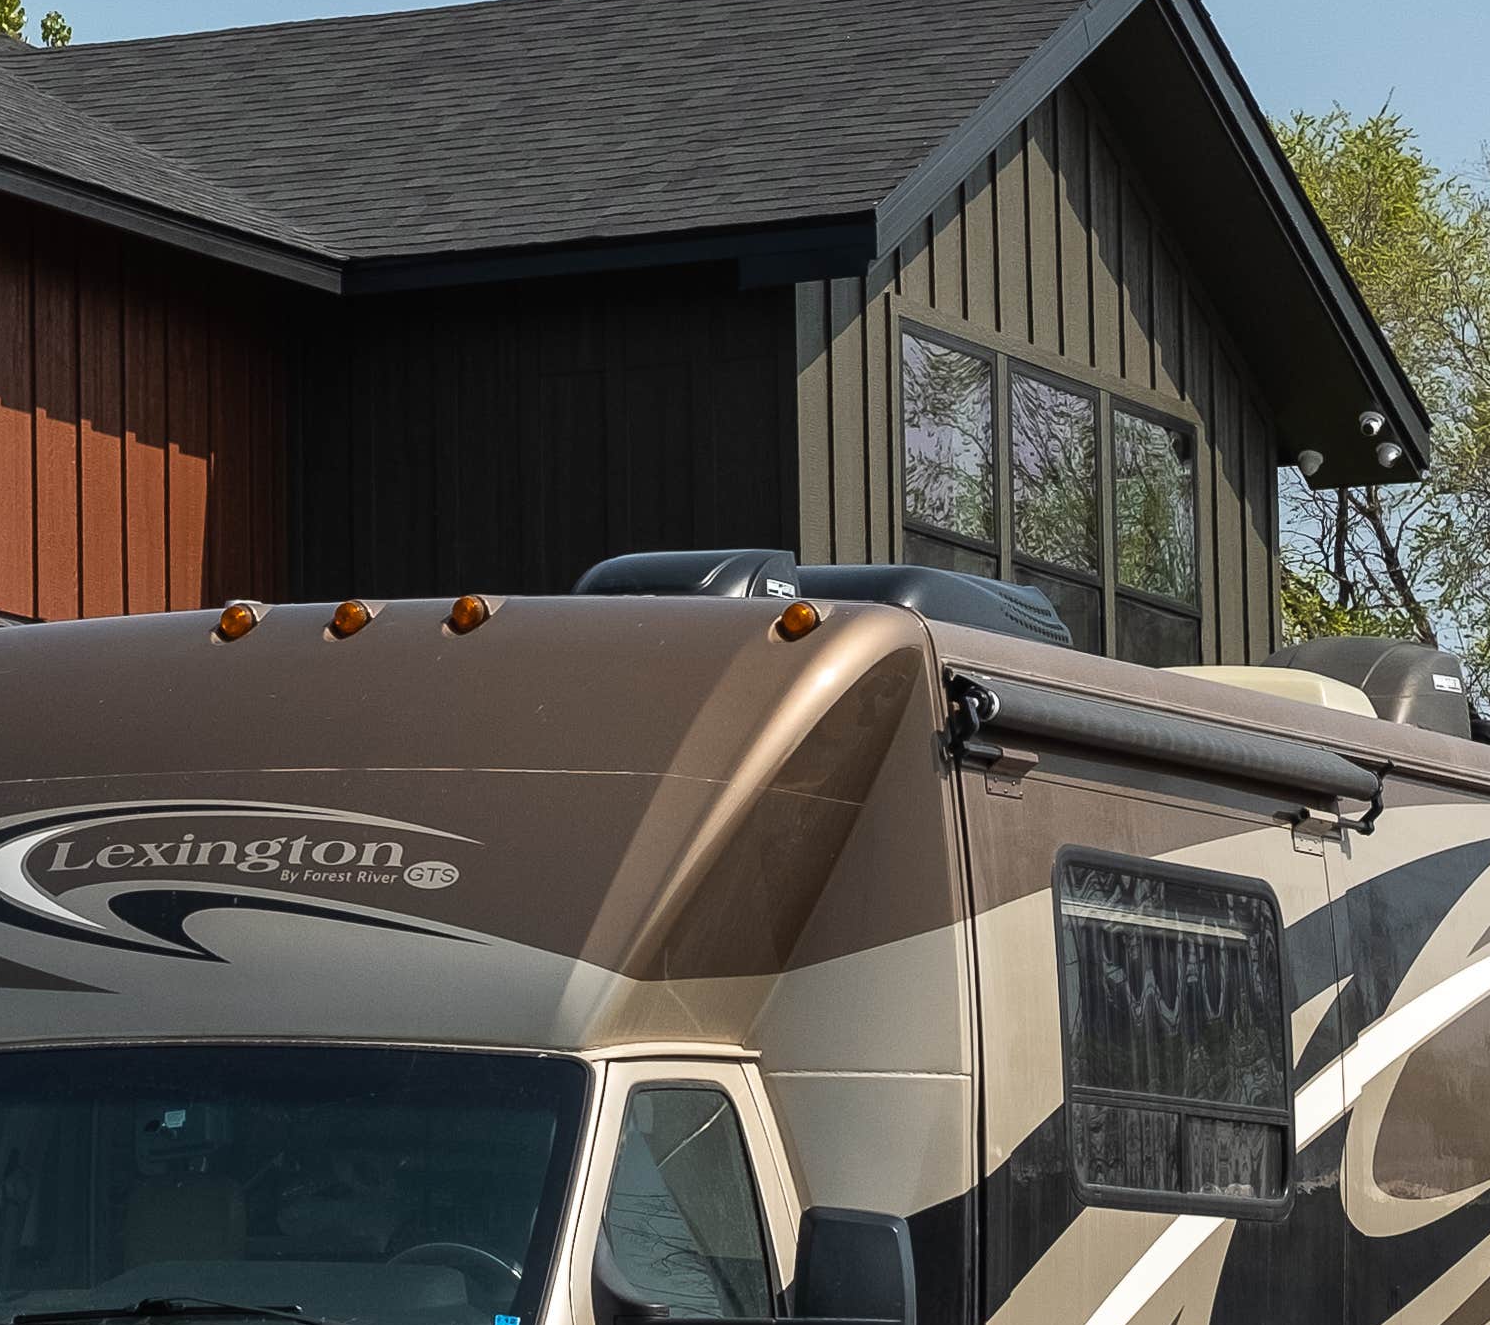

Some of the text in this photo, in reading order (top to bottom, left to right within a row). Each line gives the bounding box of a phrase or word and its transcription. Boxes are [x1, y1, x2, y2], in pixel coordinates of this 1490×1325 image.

[48, 834, 405, 872] Lexington
[280, 869, 397, 883] By Forest River
[407, 868, 454, 883] GTS
